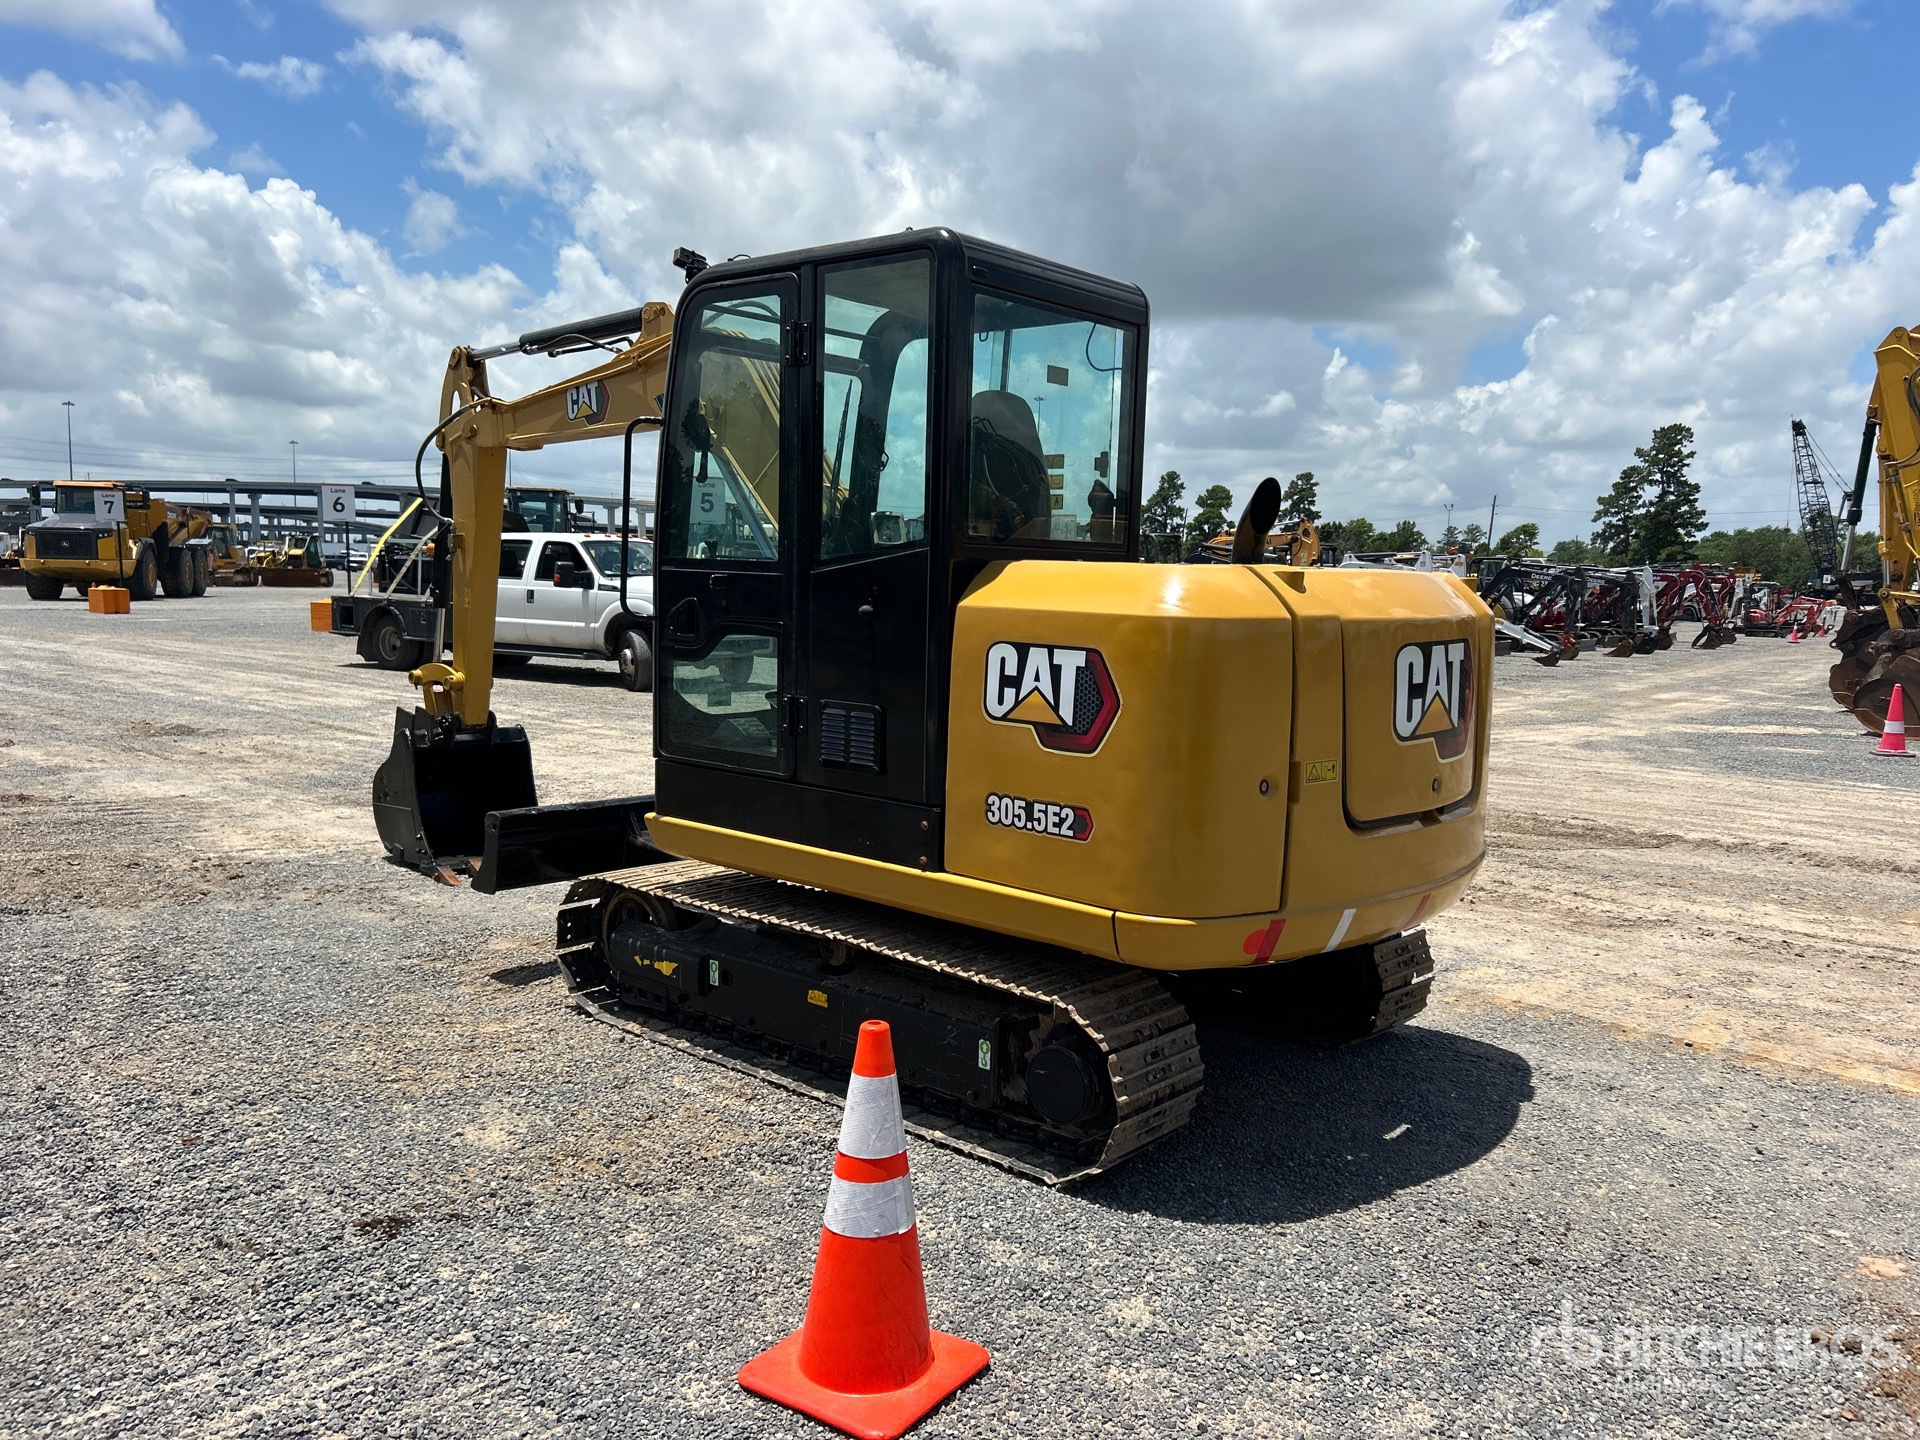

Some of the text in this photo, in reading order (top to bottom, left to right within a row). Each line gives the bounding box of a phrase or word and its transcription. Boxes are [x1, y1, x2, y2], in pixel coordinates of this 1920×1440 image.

[566, 380, 599, 420] CAT
[103, 500, 115, 514] 7
[332, 496, 346, 513] 6
[700, 492, 714, 513] 5
[1531, 573, 1552, 581] DEERE
[1586, 577, 1605, 585] DEERE
[986, 643, 1087, 727] CAT
[1395, 642, 1465, 738] CAT
[987, 795, 1075, 837] 305.5E2
